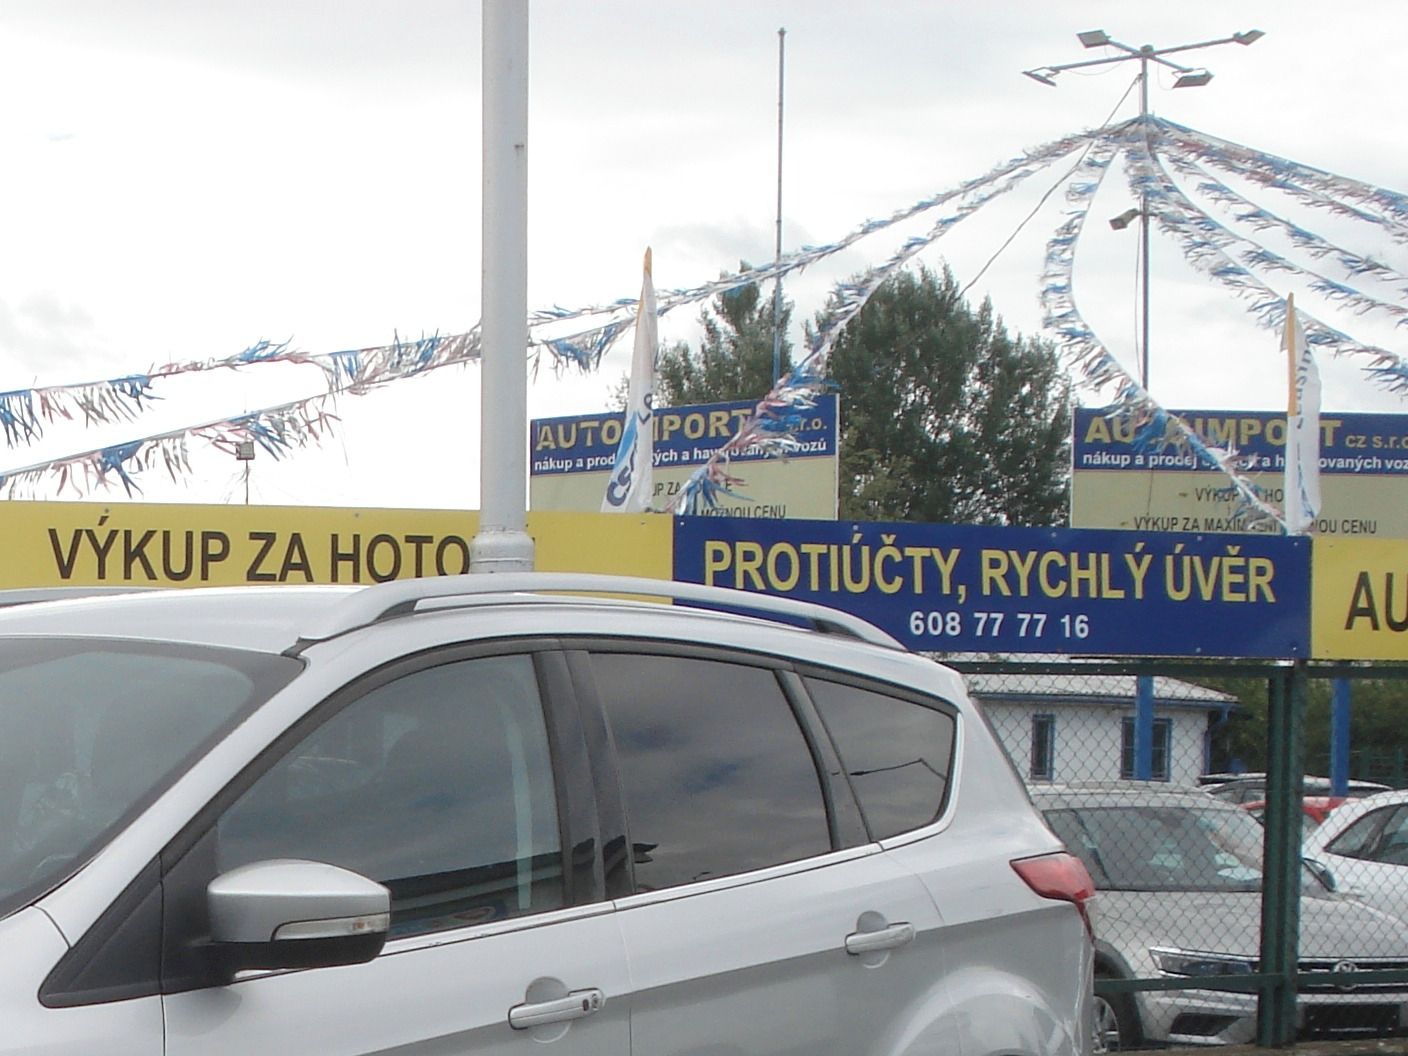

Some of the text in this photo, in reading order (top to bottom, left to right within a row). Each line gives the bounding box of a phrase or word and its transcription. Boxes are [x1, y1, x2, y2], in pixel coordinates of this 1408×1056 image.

[536, 408, 752, 451] AUTOPORT
[1084, 416, 1342, 447] AUIMPOT
[1345, 434, 1367, 449] cz
[534, 456, 573, 472] nákup
[575, 458, 584, 468] a
[586, 453, 617, 470] prod
[681, 451, 690, 461] a
[1083, 451, 1131, 468] nákup
[1135, 454, 1144, 465] a
[1261, 456, 1271, 468] a
[1134, 513, 1178, 531] VÝKUP
[1182, 517, 1200, 532] ZA
[1341, 519, 1378, 535] CENU
[47, 515, 474, 584] VÝKUP ZA HOTO
[704, 533, 1276, 605] PROTIÚČTY, RYCHLÝ ÚVĚR
[909, 611, 1089, 638] 608 77 77 16
